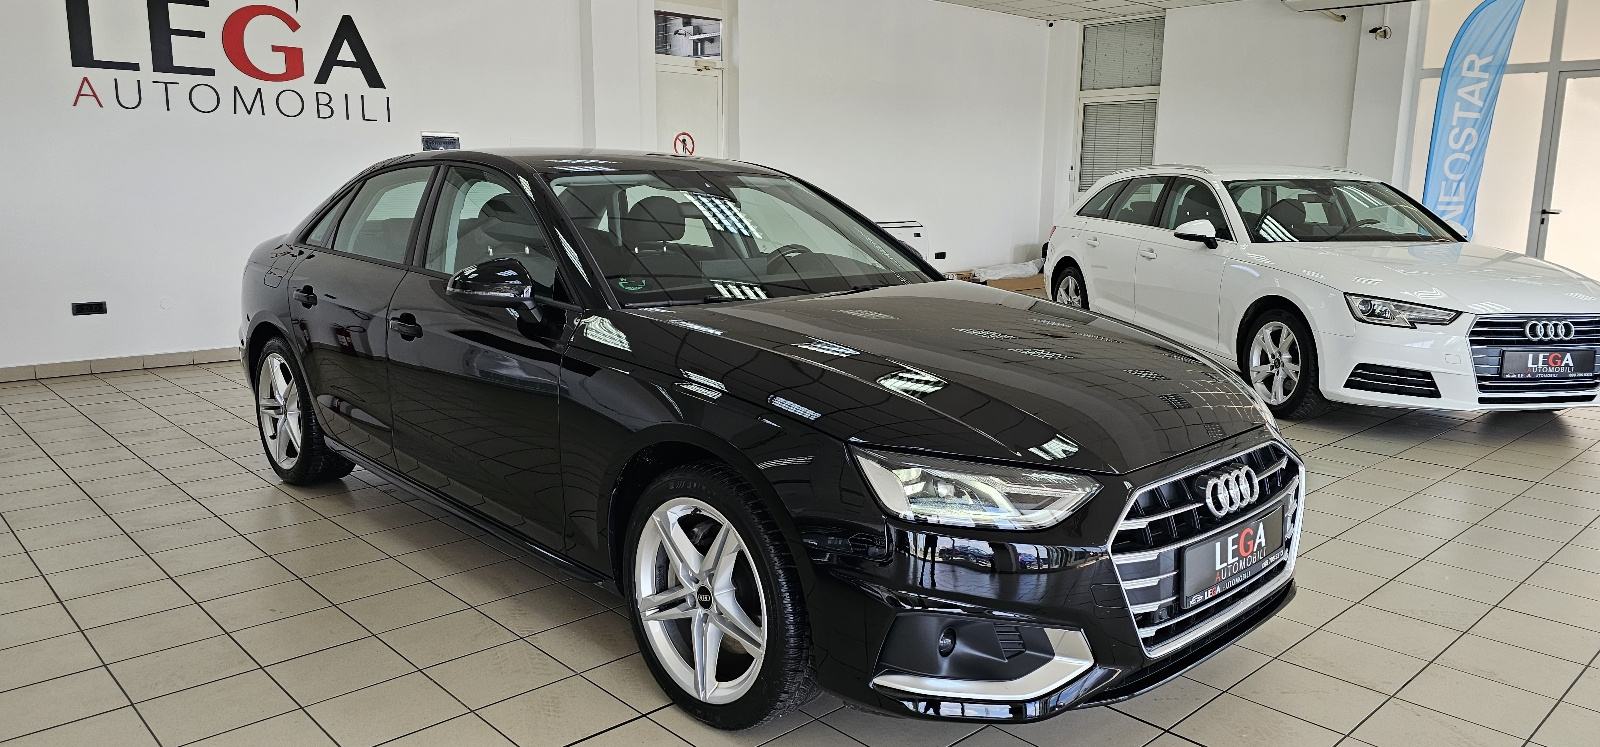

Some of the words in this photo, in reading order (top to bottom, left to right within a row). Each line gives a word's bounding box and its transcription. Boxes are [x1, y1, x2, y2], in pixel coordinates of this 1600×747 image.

[65, 0, 386, 90] LEGA
[72, 76, 392, 123] AUTOMOBILI
[1527, 353, 1574, 367] LEGA
[1215, 522, 1266, 570] LEGA
[1215, 547, 1267, 582] AUTOMOBILI
[1204, 585, 1221, 600] LEGA
